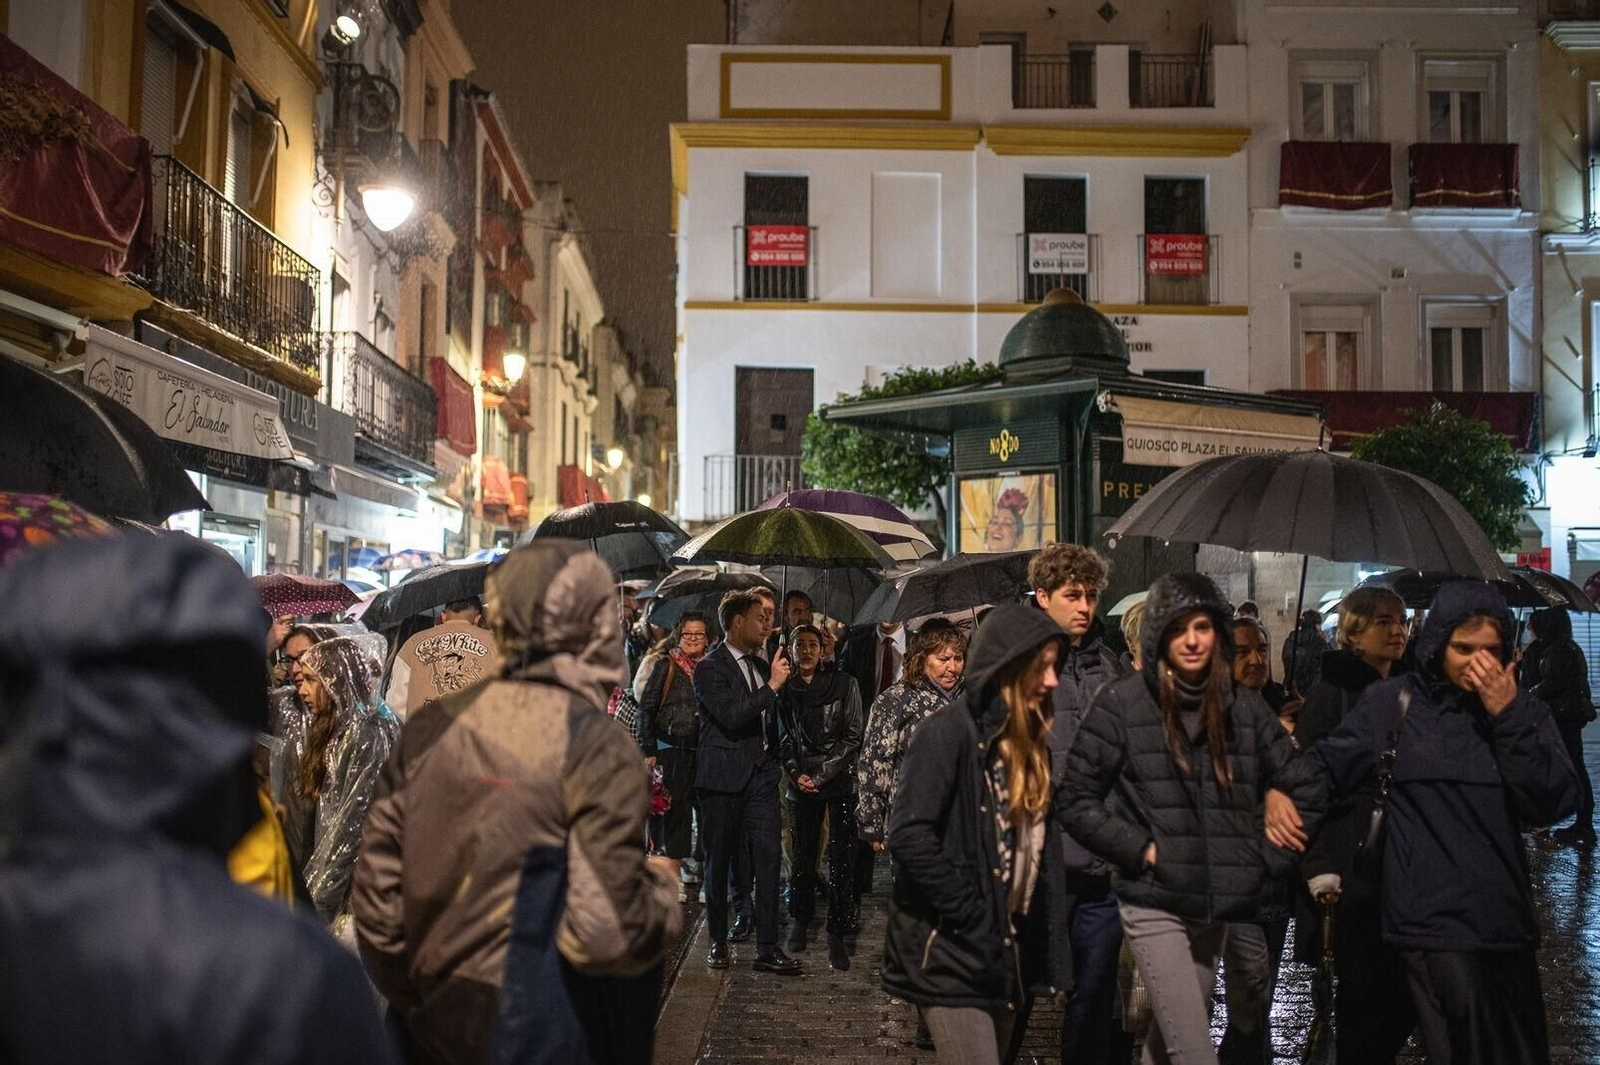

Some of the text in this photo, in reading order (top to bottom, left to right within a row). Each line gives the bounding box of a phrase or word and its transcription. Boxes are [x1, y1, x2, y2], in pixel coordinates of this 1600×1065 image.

[768, 232, 805, 244] proube
[1049, 240, 1085, 251] proube
[1166, 241, 1203, 252] proube
[1114, 316, 1138, 326] AZA
[164, 388, 230, 434] El Salvador
[1126, 437, 1179, 453] QUIOSCO
[1181, 441, 1217, 456] PLAZA
[1218, 445, 1233, 456] EL
[1103, 480, 1154, 500] PRE
